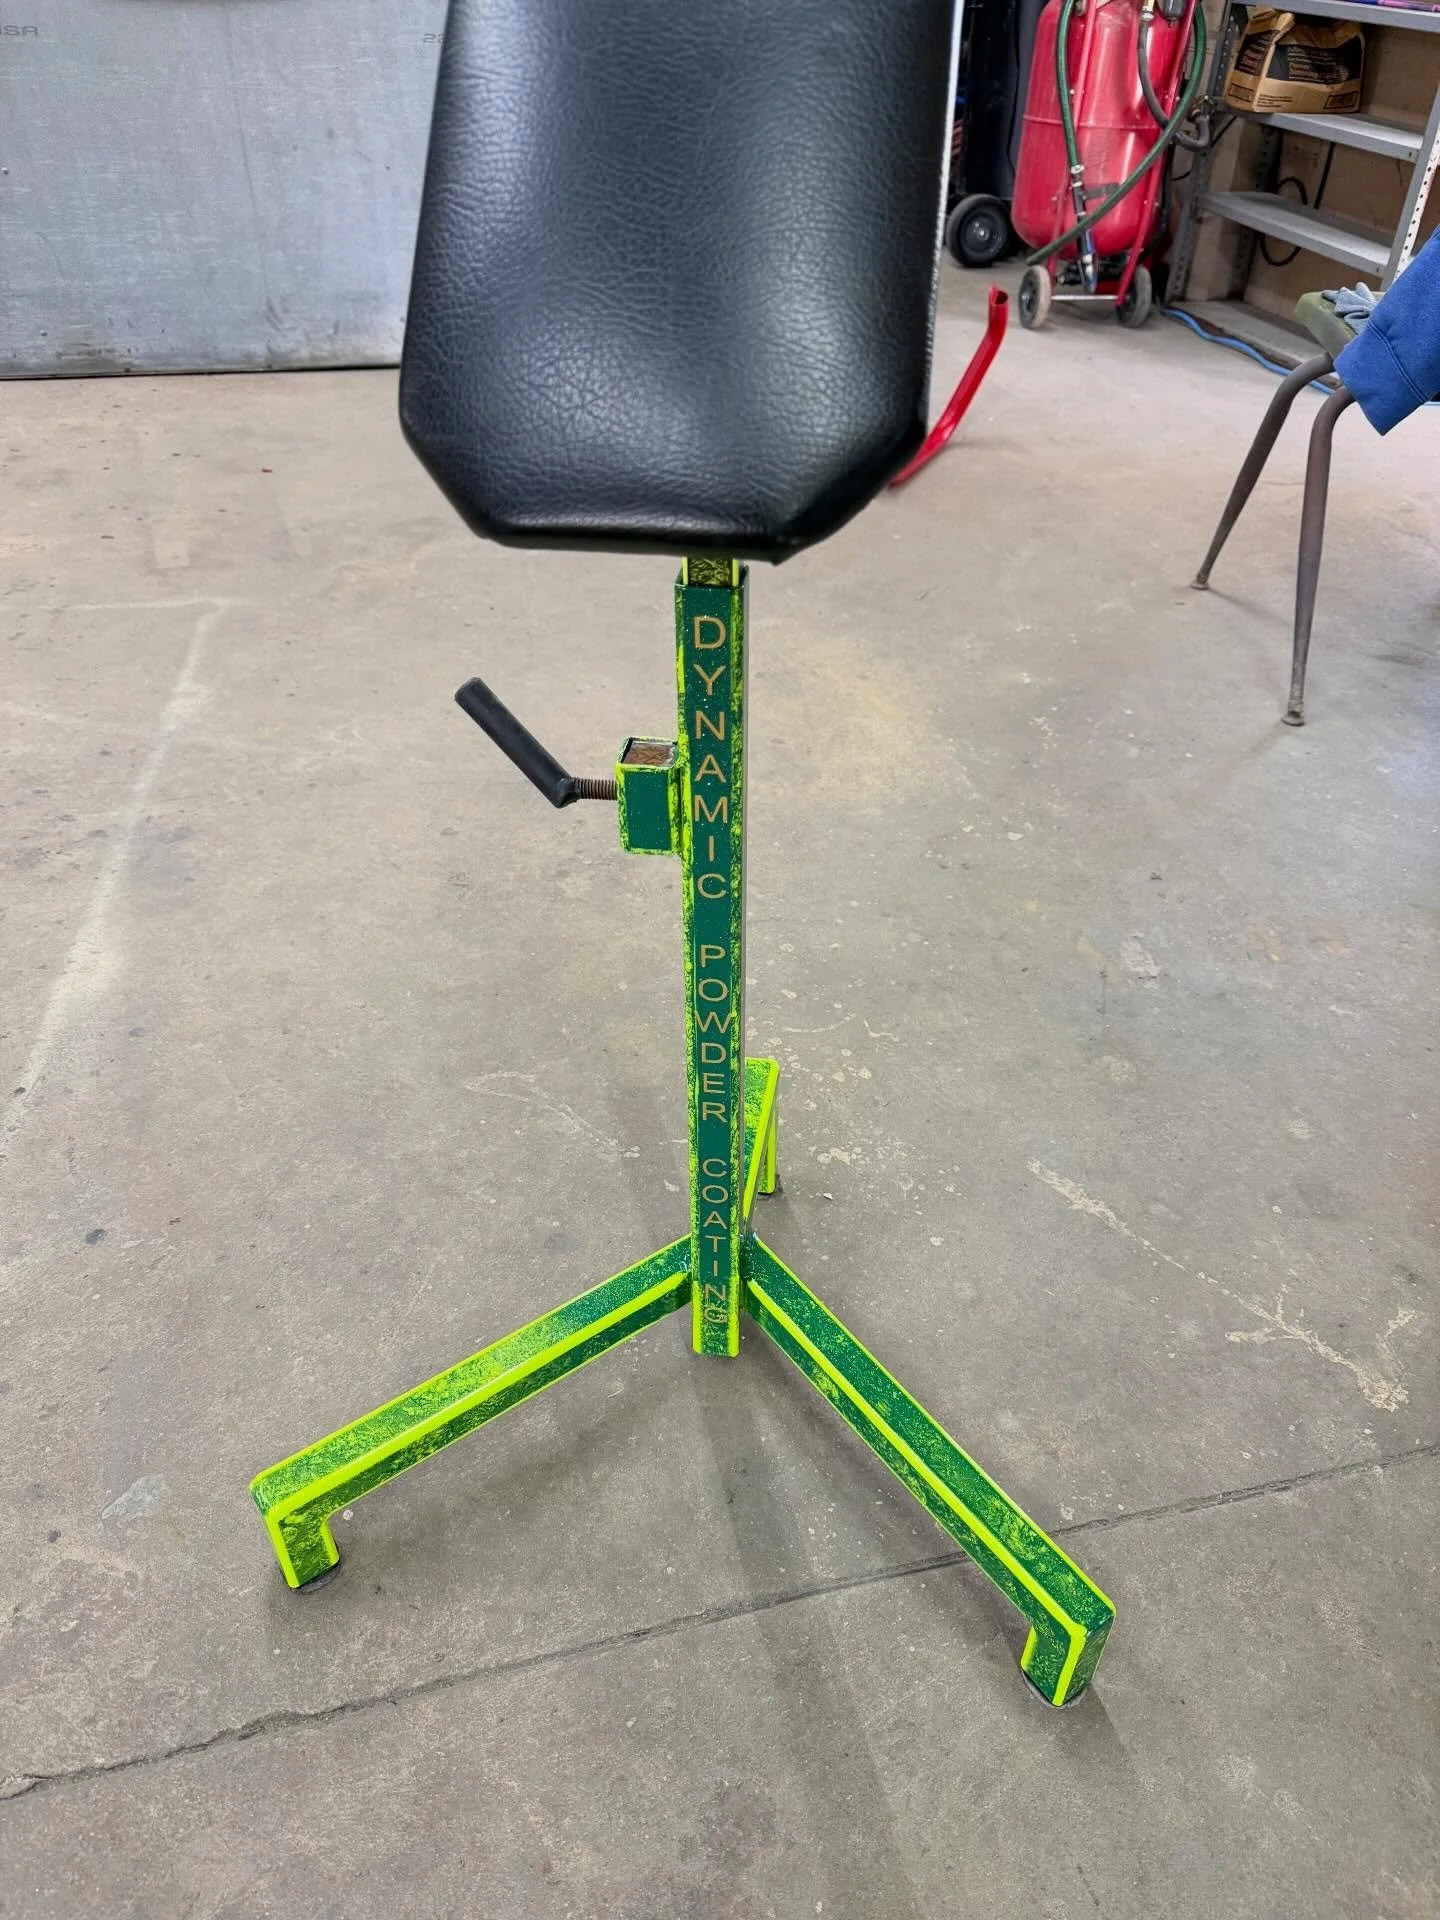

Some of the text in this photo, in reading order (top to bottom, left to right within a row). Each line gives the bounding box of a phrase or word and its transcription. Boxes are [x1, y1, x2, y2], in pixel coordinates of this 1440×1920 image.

[0, 25, 38, 36] SA
[693, 616, 732, 1323] DYNAMIC POWDER COATING
